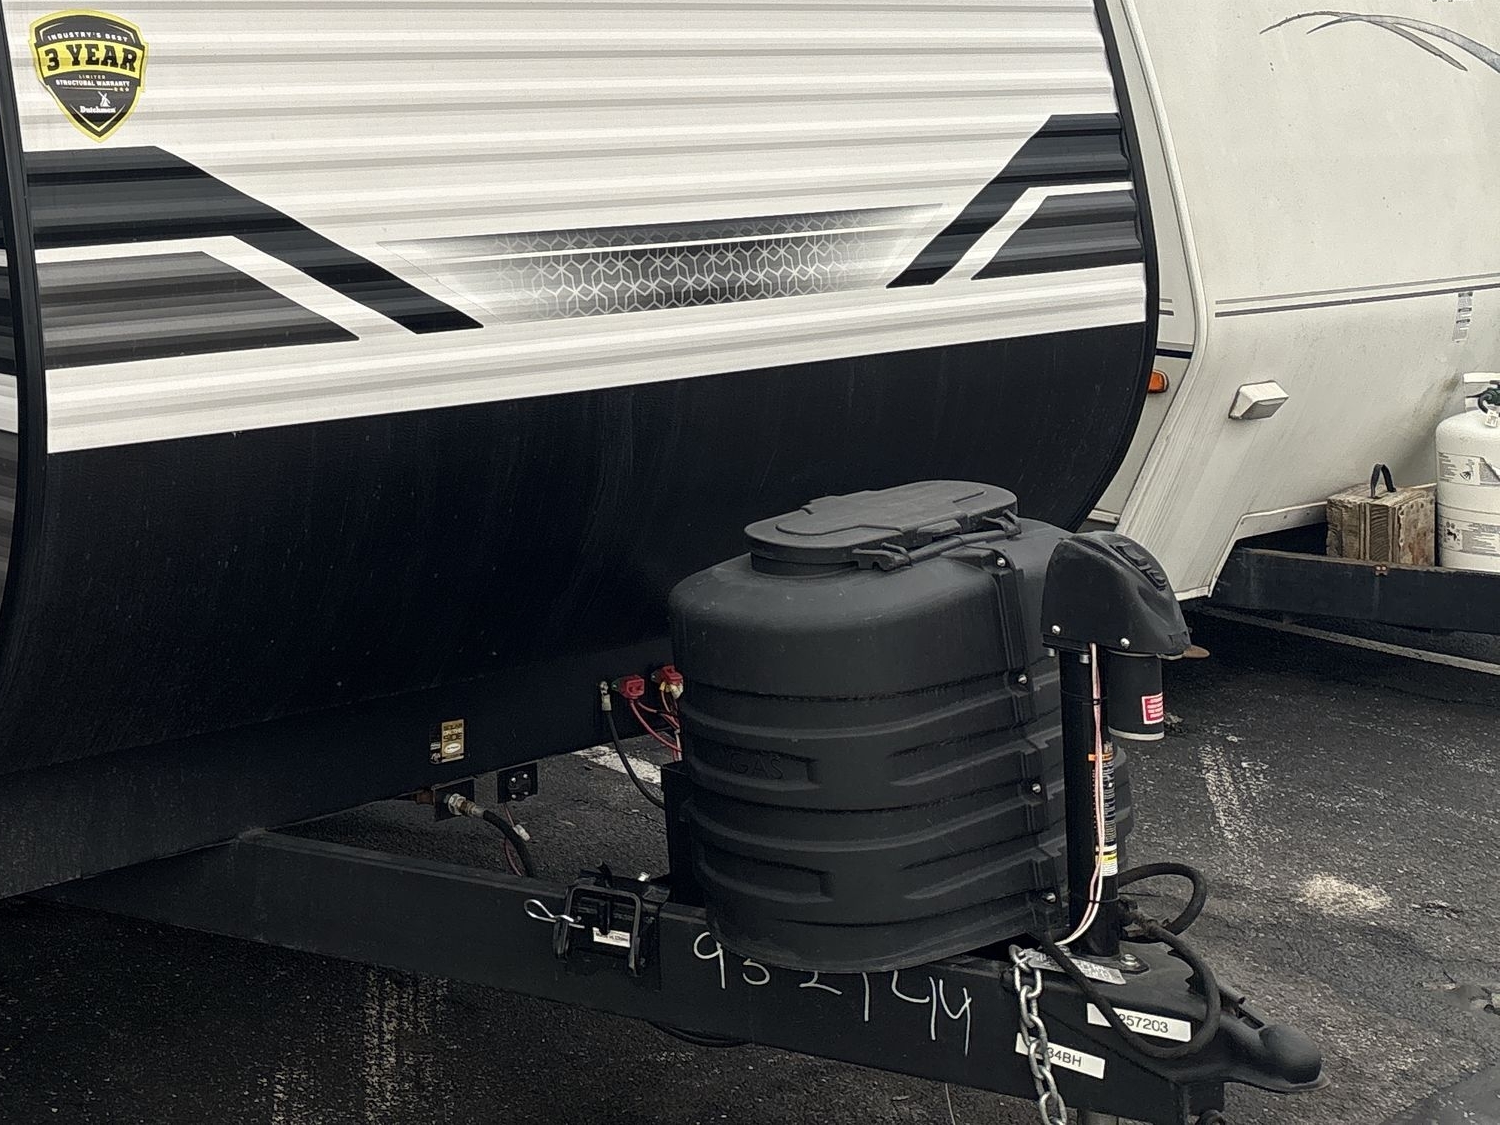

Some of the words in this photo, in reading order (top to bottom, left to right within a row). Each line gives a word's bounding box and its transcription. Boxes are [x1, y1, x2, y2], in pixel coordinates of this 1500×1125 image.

[47, 31, 102, 41] INDUSTRY'S
[105, 33, 128, 43] BEST
[45, 48, 60, 71] 3
[66, 43, 138, 73] YEAR
[79, 105, 117, 114] Dutchmen
[728, 748, 785, 780] GAS
